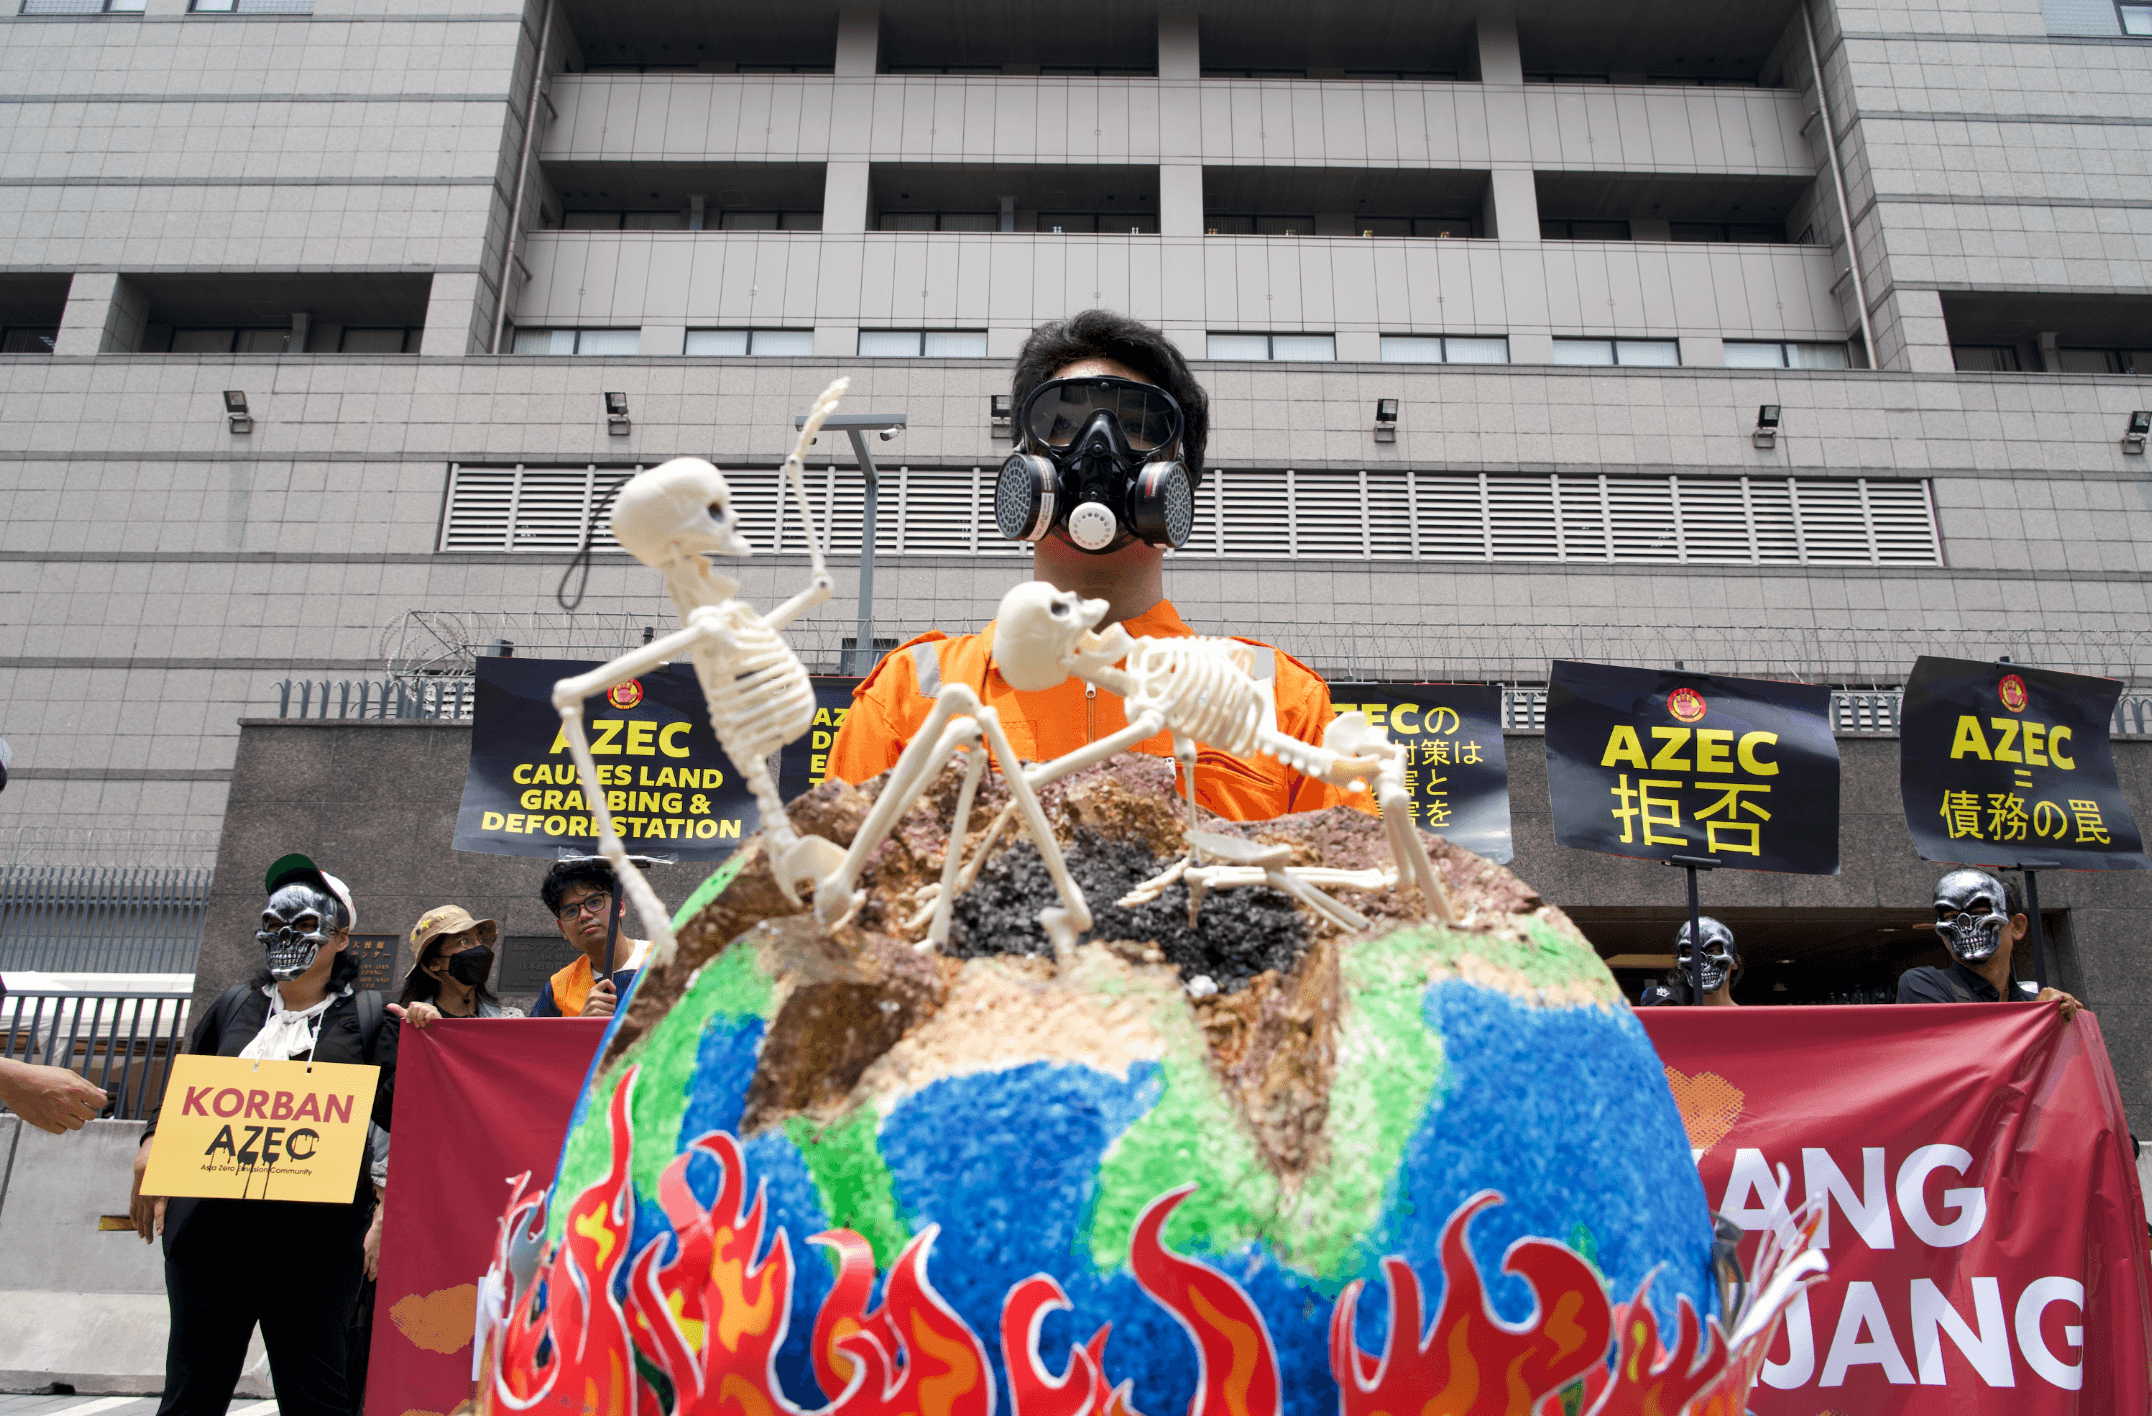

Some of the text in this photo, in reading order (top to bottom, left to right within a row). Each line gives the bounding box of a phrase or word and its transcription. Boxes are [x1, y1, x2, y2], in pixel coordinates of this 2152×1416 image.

[1600, 724, 1780, 776] AZEC
[1950, 714, 2076, 770] AZEC
[639, 765, 724, 789] LAND
[520, 789, 712, 815] GRABING &
[1611, 773, 1772, 857] 拒否
[1939, 789, 2112, 845] 債務の罠
[182, 1086, 354, 1124] KORBAN
[204, 1124, 320, 1164] AZEC
[219, 1164, 235, 1172] Zero
[270, 1166, 312, 1176] Community
[1691, 1143, 1986, 1250] ANG
